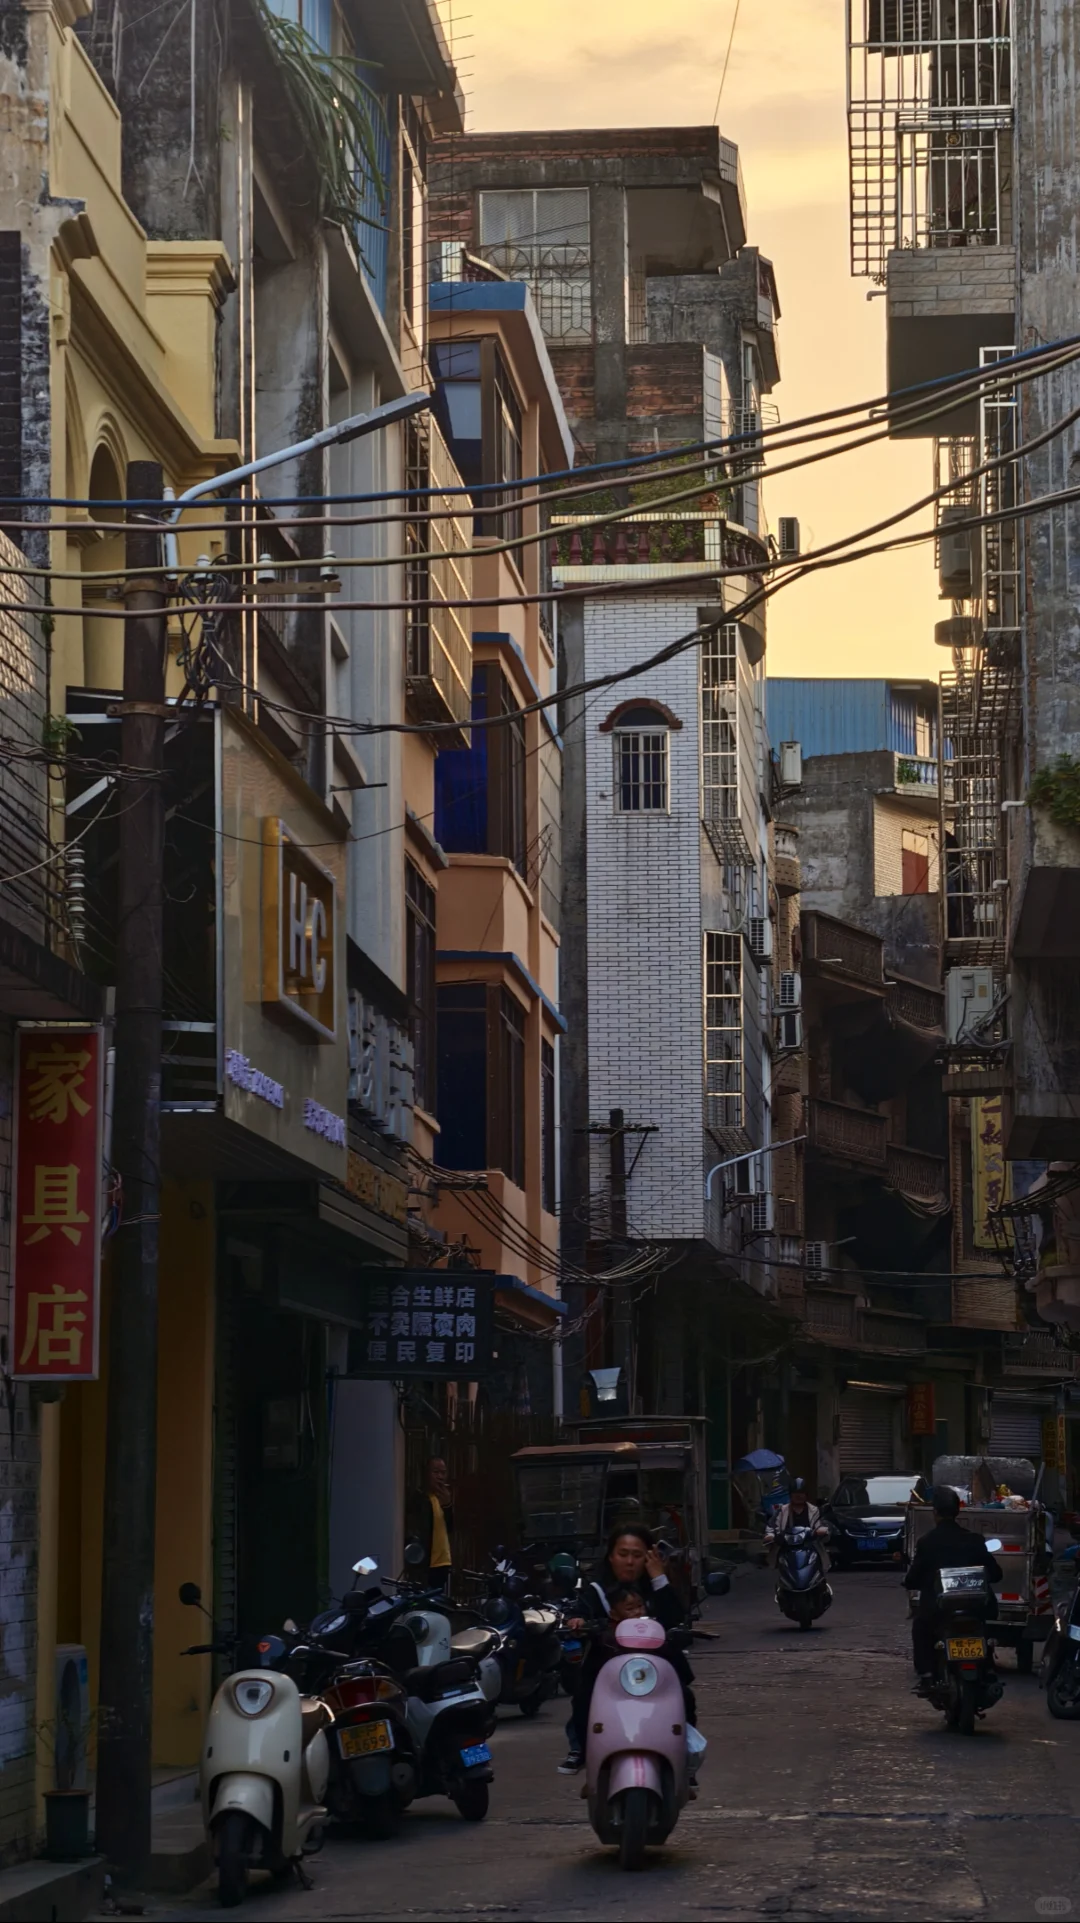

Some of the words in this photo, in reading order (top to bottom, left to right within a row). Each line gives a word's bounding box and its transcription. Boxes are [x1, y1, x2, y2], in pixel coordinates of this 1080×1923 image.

[289, 871, 327, 994] HC
[19, 1042, 92, 1366] 家具店
[368, 1285, 476, 1308] 综合生鲜店
[367, 1311, 476, 1337] 不卖隔夜肉
[367, 1340, 475, 1364] 便民复印
[952, 1647, 982, 1657] EK862
